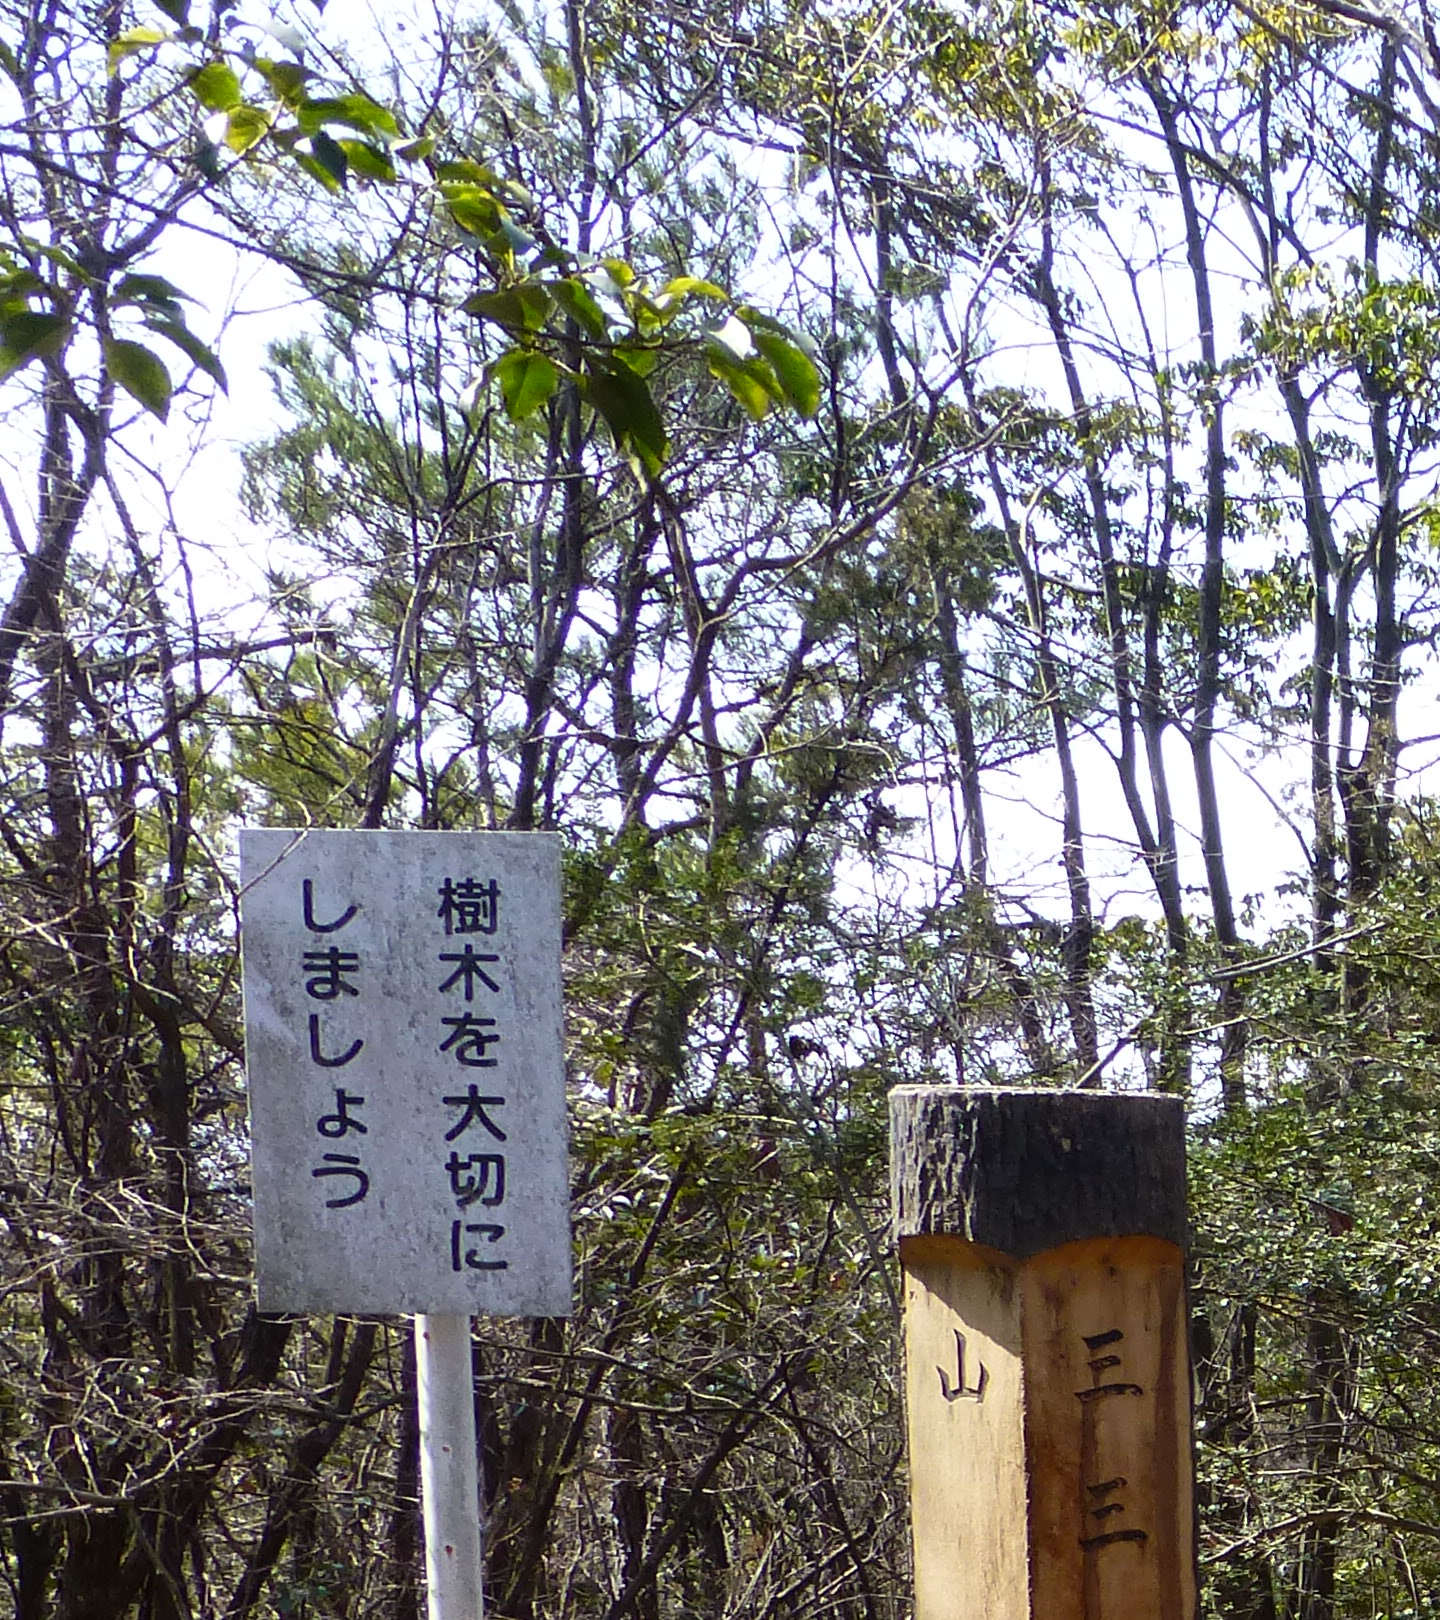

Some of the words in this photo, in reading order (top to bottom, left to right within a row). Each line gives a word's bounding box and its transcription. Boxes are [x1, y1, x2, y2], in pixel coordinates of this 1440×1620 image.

[302, 877, 371, 1209] しましょう
[437, 876, 509, 1273] 樹木を大切に
